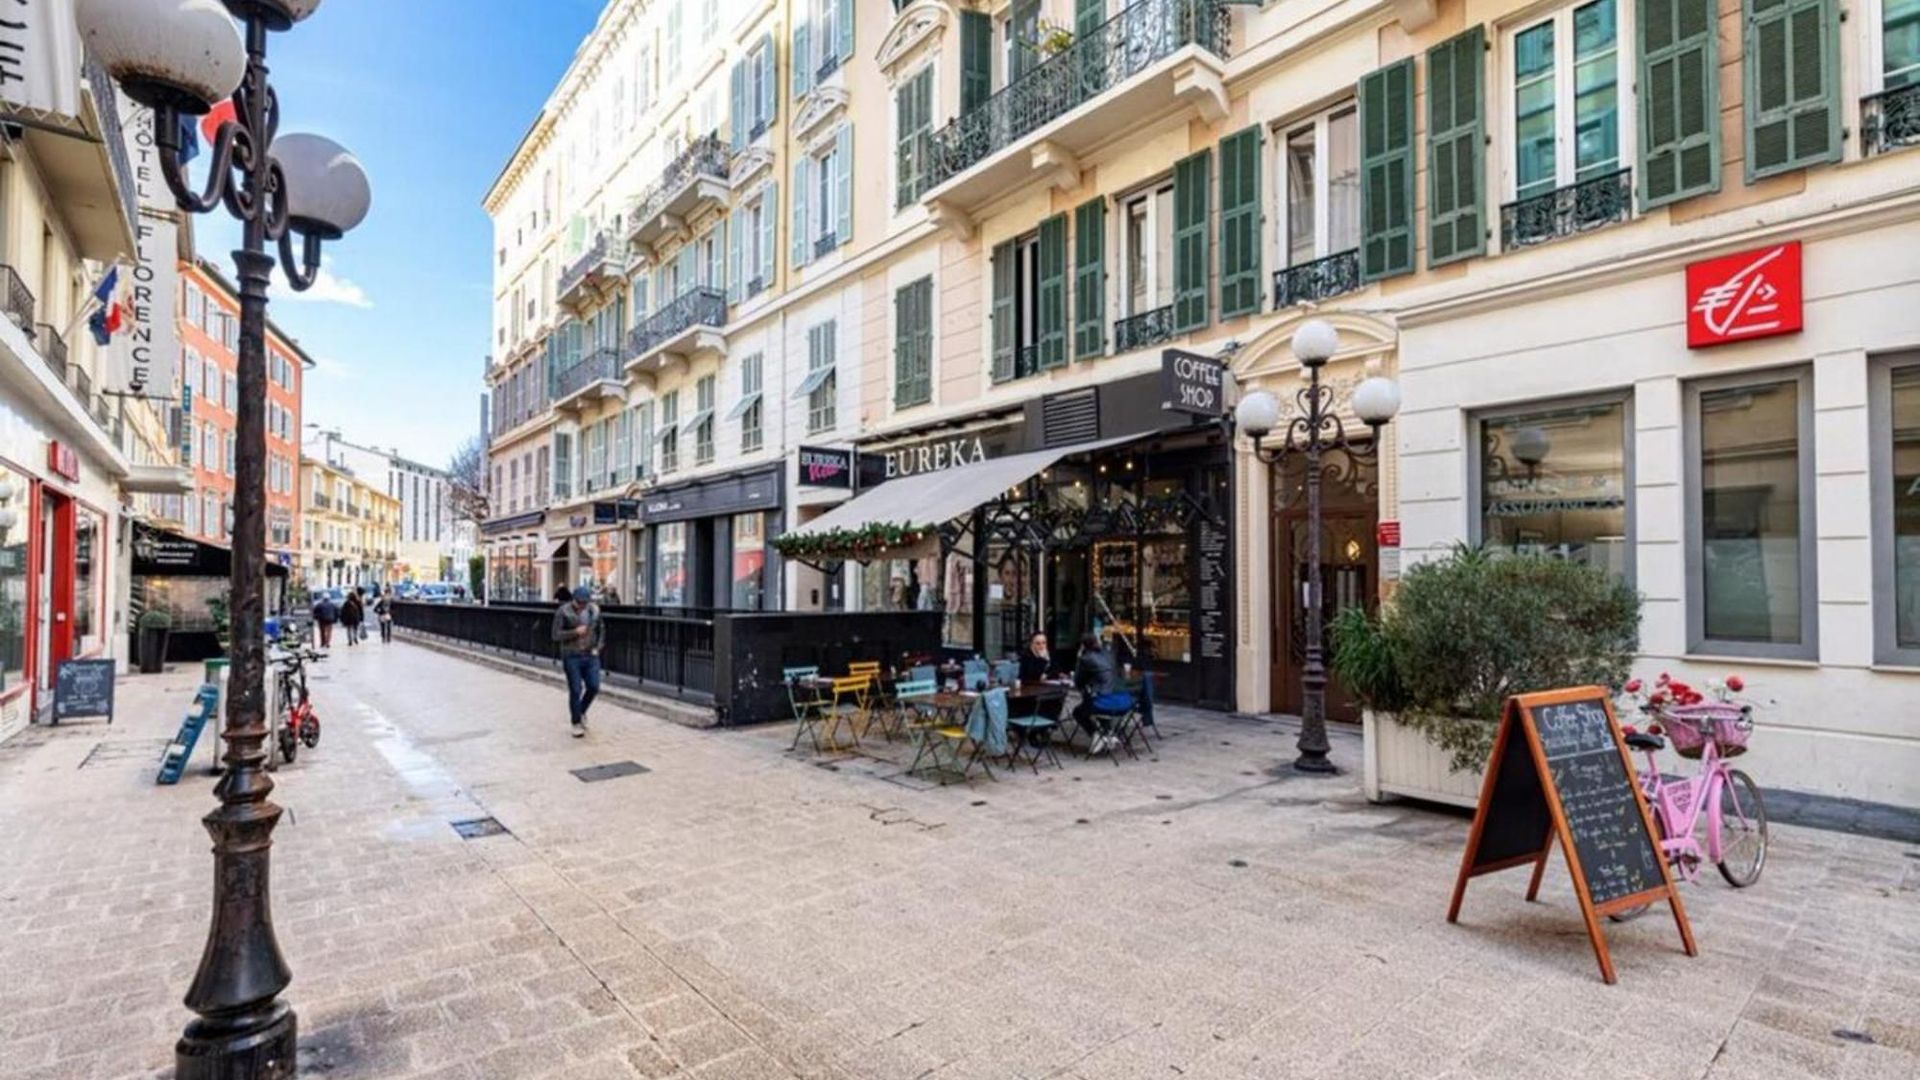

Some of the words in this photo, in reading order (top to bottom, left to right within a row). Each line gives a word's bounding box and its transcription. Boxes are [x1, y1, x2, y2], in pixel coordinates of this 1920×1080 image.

[131, 225, 155, 386] FLORENCE
[1174, 357, 1219, 386] COFFEE
[1180, 383, 1214, 409] SHOP
[884, 437, 986, 478] EUREKA
